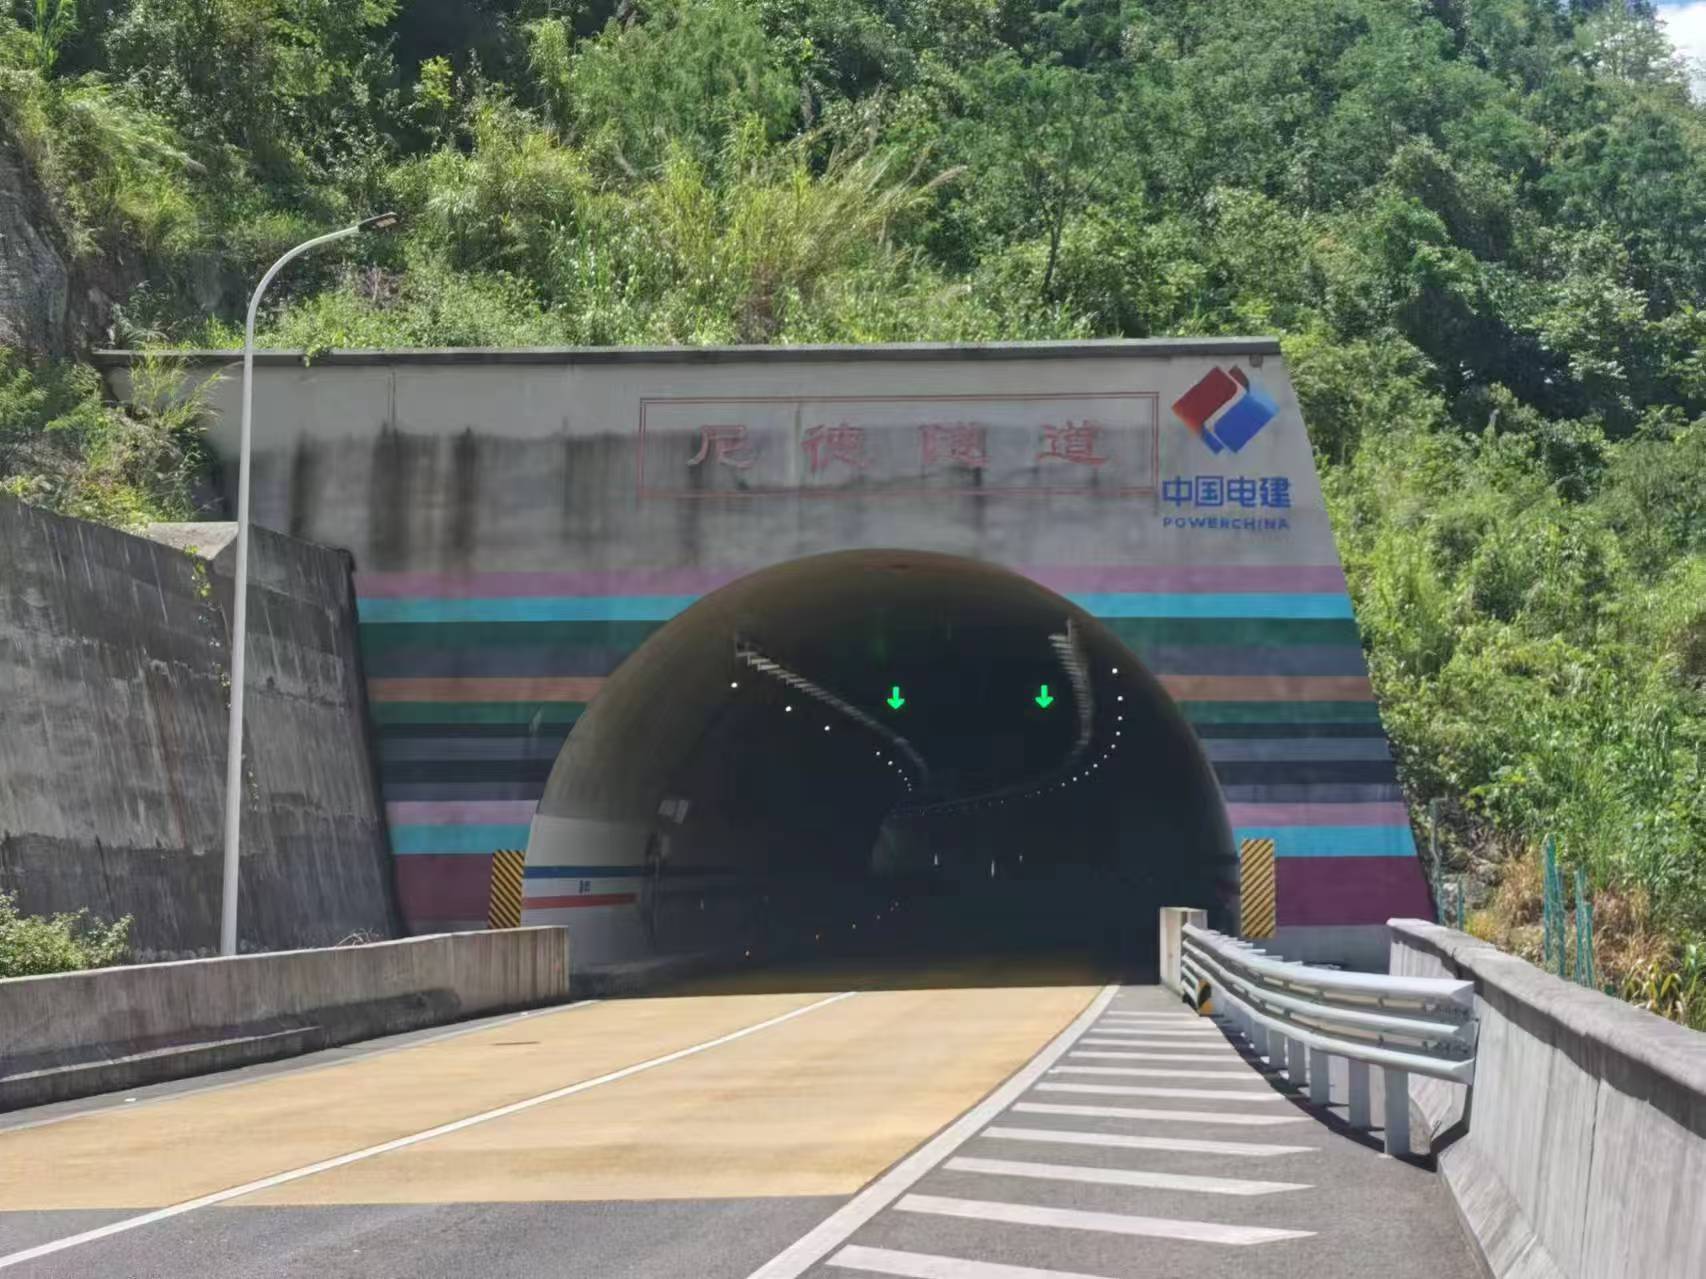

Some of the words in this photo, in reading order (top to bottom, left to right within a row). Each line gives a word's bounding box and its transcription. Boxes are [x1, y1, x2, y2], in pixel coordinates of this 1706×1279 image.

[1162, 475, 1291, 508] 中国电建
[1163, 517, 1289, 529] POWERCHINA
